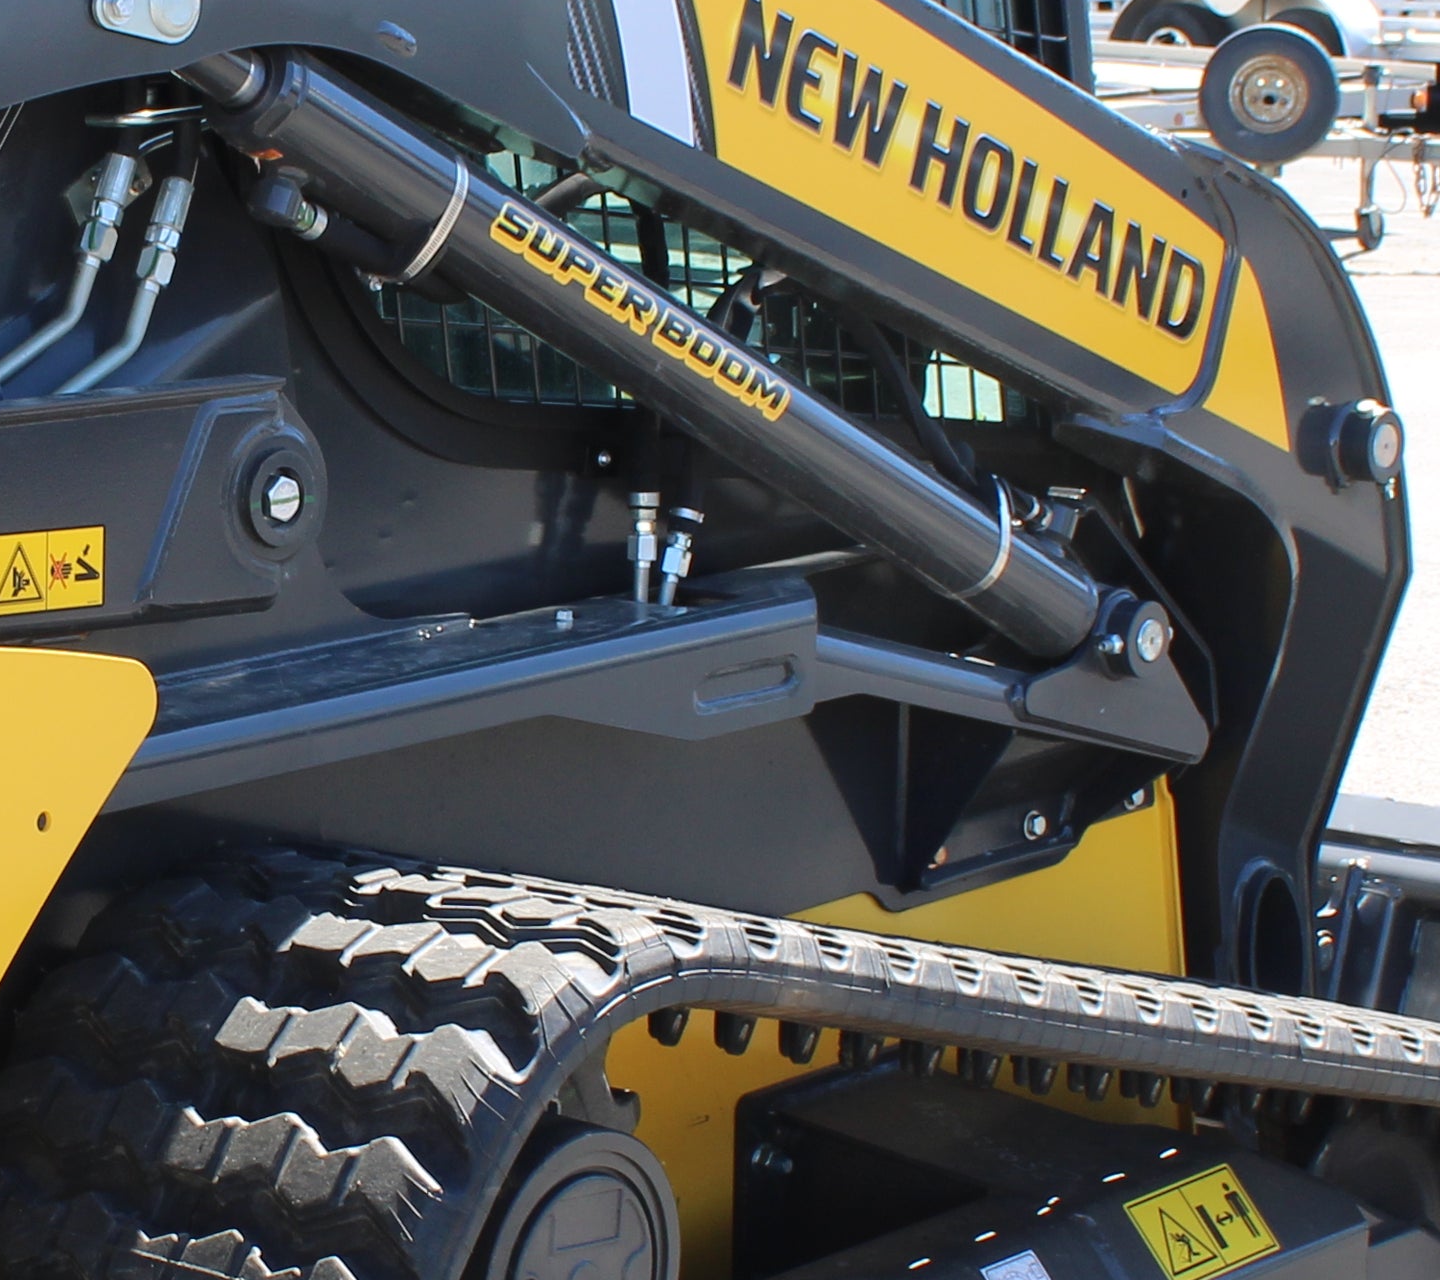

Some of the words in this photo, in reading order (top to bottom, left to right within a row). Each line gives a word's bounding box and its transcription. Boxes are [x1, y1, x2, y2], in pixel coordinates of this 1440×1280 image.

[490, 202, 658, 335] SUPER
[653, 307, 791, 422] BOOM
[909, 99, 1205, 340] HOLLAND
